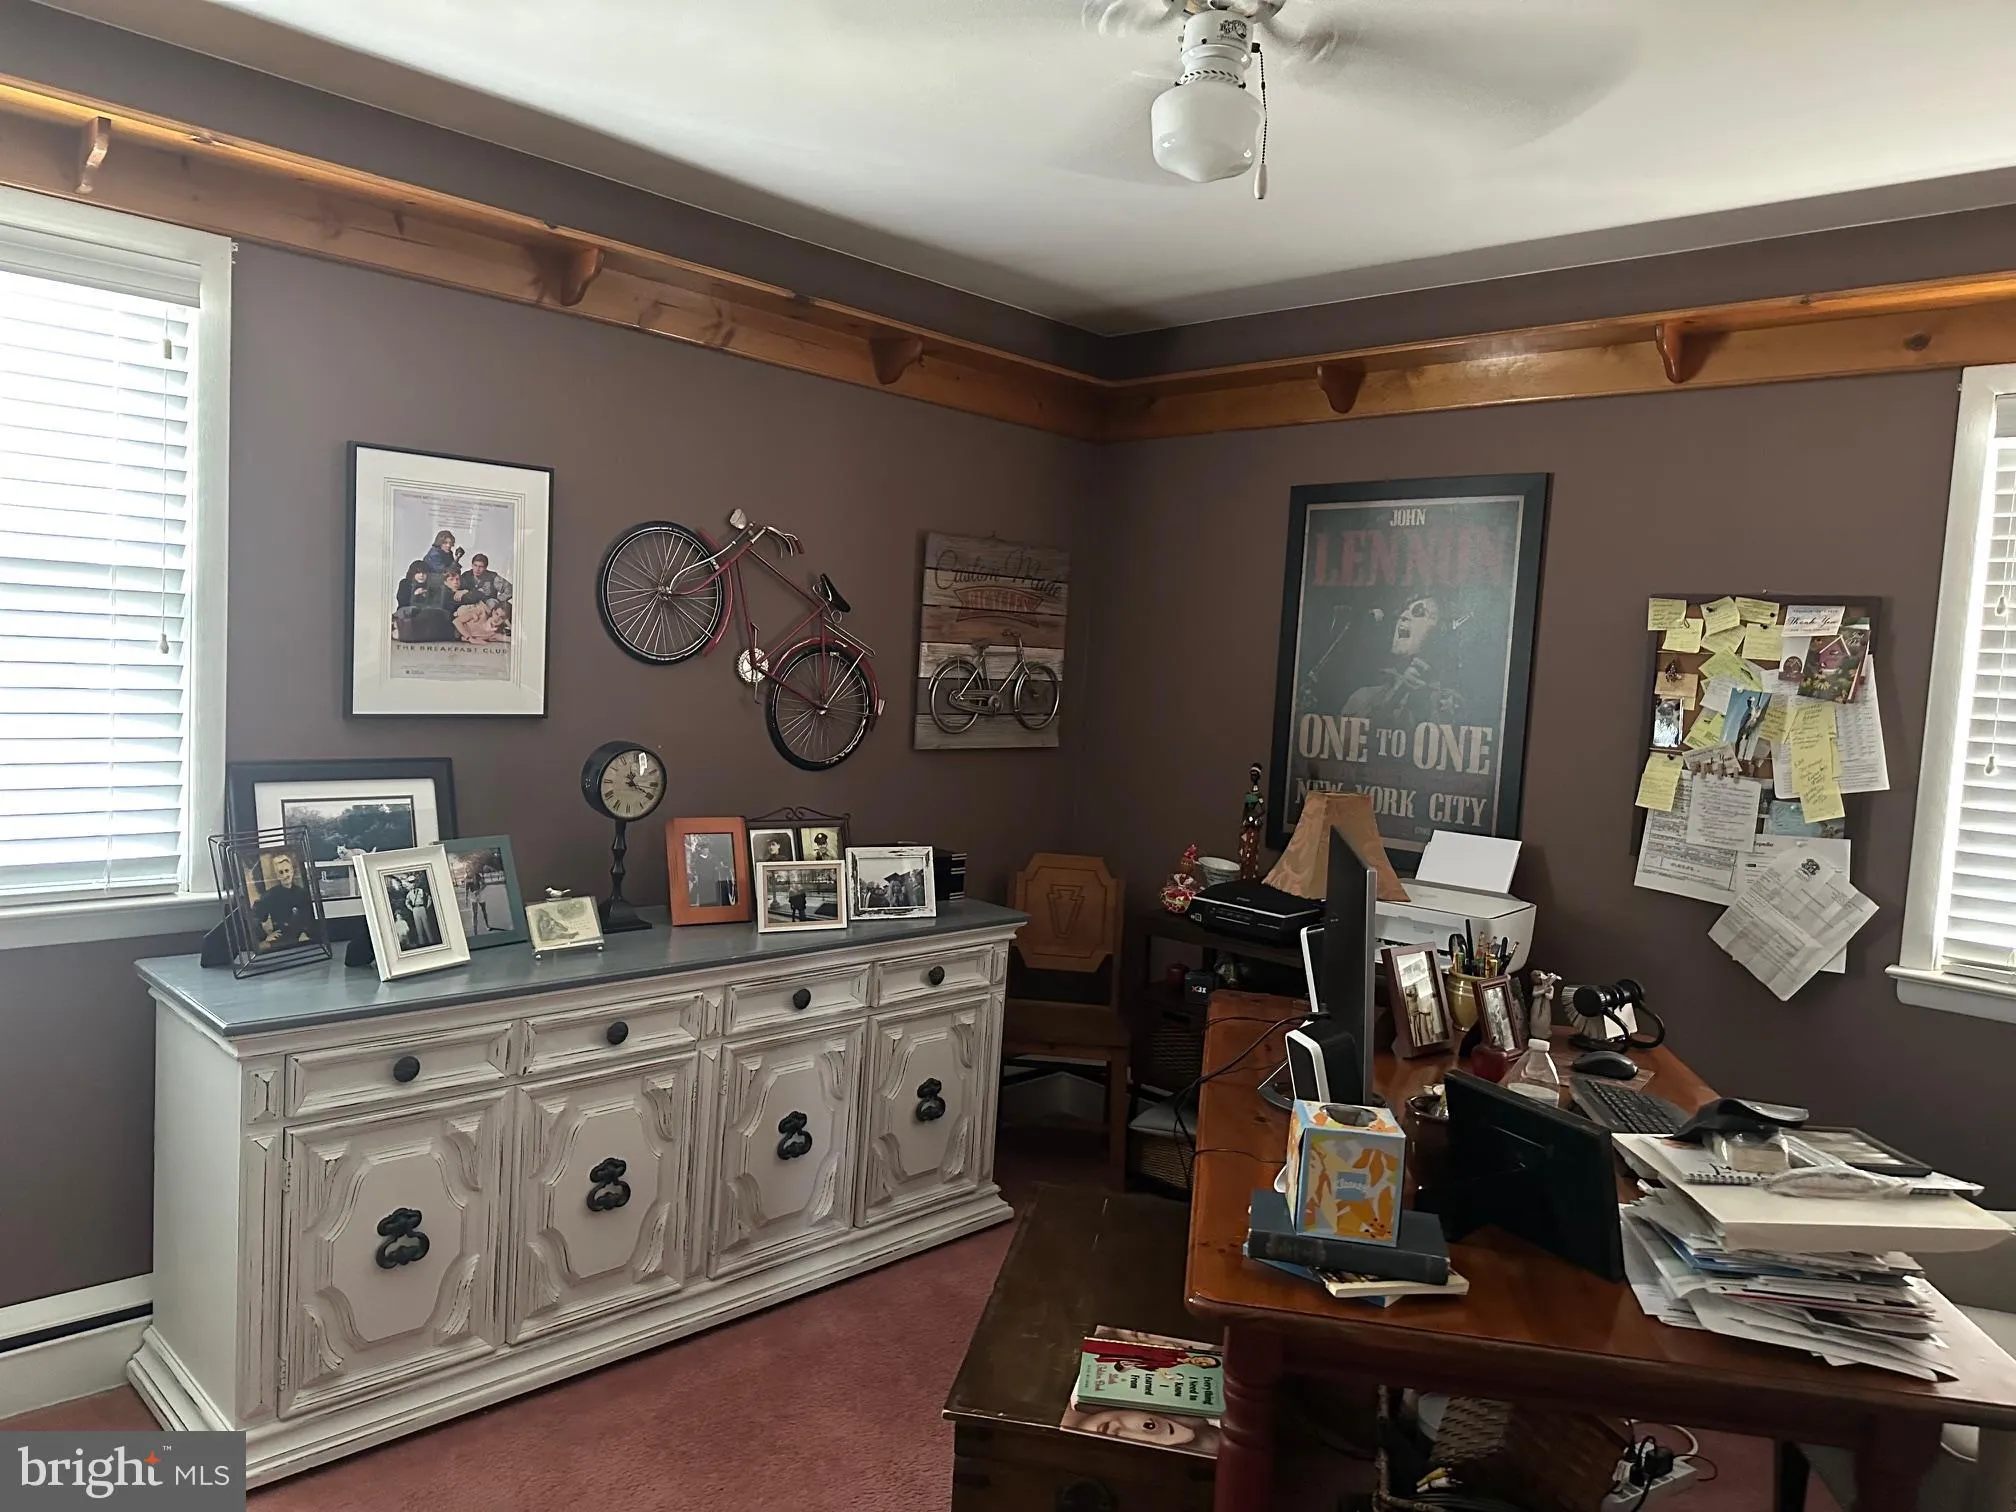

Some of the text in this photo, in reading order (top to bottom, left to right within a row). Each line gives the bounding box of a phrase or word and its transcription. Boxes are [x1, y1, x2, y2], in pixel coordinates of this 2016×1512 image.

[1390, 508, 1427, 527] JOHN
[1312, 525, 1505, 587] LENNON
[420, 645, 478, 653] BREAKFAST
[1299, 713, 1494, 775] ONE TO ONE
[1429, 792, 1487, 827] CITY
[1129, 1374, 1140, 1389] From
[1144, 1373, 1154, 1396] Learned
[1174, 1381, 1183, 1397] Know
